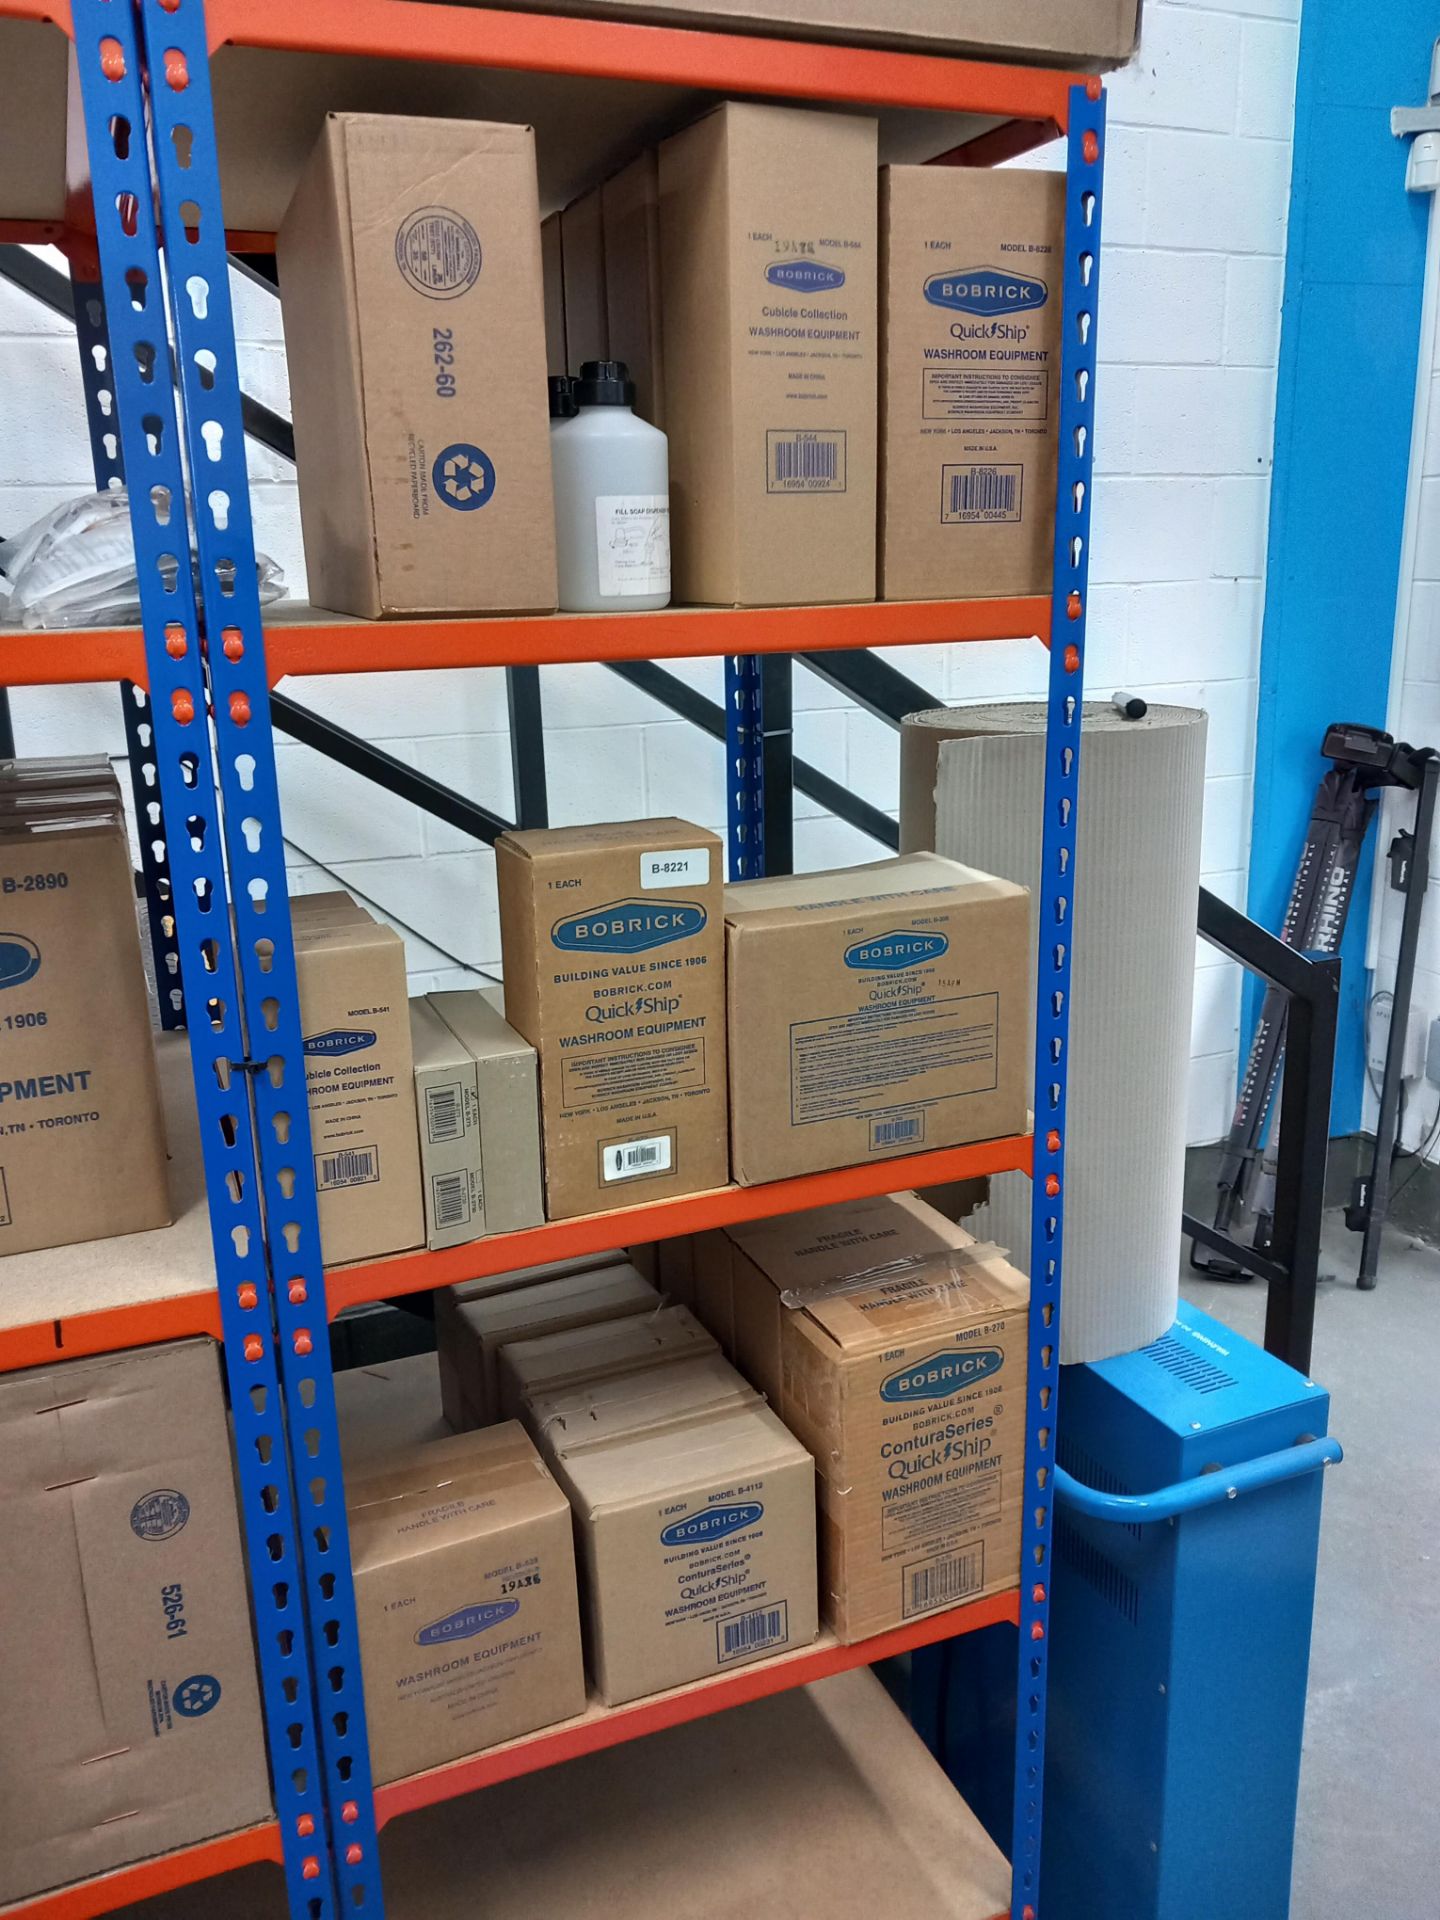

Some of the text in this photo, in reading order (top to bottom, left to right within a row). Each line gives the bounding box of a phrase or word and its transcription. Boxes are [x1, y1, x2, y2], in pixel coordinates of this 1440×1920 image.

[753, 232, 772, 241] EACH
[819, 239, 841, 248] MODEL
[930, 241, 951, 250] EACH
[1000, 244, 1027, 253] MODEL
[776, 269, 835, 282] BOBRICK
[942, 283, 1031, 299] BOBRICK
[762, 306, 848, 320] Cubicle Collection
[749, 327, 860, 340] WASHROOM EQUIPMENT
[433, 328, 456, 398] 262-60
[924, 348, 1048, 362] WASHROOM EQUIPMENT
[407, 433, 420, 519] RECYCLED PAPERBOARD
[417, 439, 429, 515] CARTON MADE FROM
[970, 467, 997, 476] B-8226
[783, 479, 805, 488] 16954
[958, 511, 980, 519] 16954
[984, 511, 1007, 519] 00445
[651, 861, 689, 874] B-8221
[2, 872, 69, 894] B-2890
[556, 879, 582, 889] EACH
[794, 897, 865, 912] HANDLE
[869, 892, 908, 902] WITH
[1311, 866, 1345, 952] RHINO
[575, 913, 686, 939] BOBRICK
[847, 928, 864, 936] EACH
[859, 941, 934, 960] BOBRICK
[554, 956, 707, 983] BUILDING VALUE SINCE 1906
[858, 975, 886, 984] BUILDING
[593, 980, 672, 999] BOBRICK.COM
[347, 1006, 390, 1017] MODEL B-541
[858, 995, 935, 1013] WASHROOM EQUIPMENT
[4, 1012, 48, 1030] 1906
[559, 1017, 706, 1048] WASHROOM EQUIPMENT
[308, 1035, 366, 1050] BOBRICK
[571, 1057, 606, 1067] IMPORTANT
[608, 1051, 651, 1062] INSTRUCTIONS
[661, 1044, 696, 1054] CONSIGNEE
[333, 1063, 381, 1077] Collection
[1239, 1022, 1271, 1126] INTERNATIONAL
[342, 1077, 395, 1091] EQUIPMENT
[610, 1100, 637, 1111] ANGELES
[684, 1087, 711, 1097] TORONTO
[36, 1111, 99, 1129] TORONTO
[794, 1229, 899, 1257] HANDLE WITH CARE
[816, 1228, 863, 1244] FRAGILE
[879, 1277, 929, 1295] FRAGILE
[859, 1295, 906, 1312] HANDLE
[908, 1287, 937, 1300] WITH
[956, 1322, 1005, 1342] MODEL B-270
[878, 1349, 905, 1363] 1 EACH
[899, 1356, 988, 1392] BOBRICK
[882, 1408, 925, 1426] BUILDING
[927, 1399, 956, 1413] VALUE
[958, 1391, 983, 1405] SINCE
[912, 1406, 975, 1431] BOBRICK.COM
[882, 1455, 1003, 1501] WASHROOM EQUIPMENT
[708, 1482, 763, 1503] MODEL B-4112
[397, 1499, 497, 1534] HANDLE WITH CARE
[420, 1500, 465, 1518] FRAGILE
[664, 1503, 687, 1515] EACH
[676, 1510, 749, 1538] BOBRICK
[663, 1549, 699, 1565] BUILDING
[701, 1543, 723, 1554] VALUE
[725, 1535, 747, 1546] SINCE
[689, 1549, 740, 1569] BOBRICK.COM
[484, 1565, 513, 1580] MODEL
[390, 1597, 416, 1611] EACH
[665, 1596, 717, 1617] WASHROOM
[718, 1581, 766, 1602] EQUIPMENT
[160, 1583, 188, 1640] 526-61
[430, 1605, 506, 1638] BOBRICK
[396, 1656, 470, 1688] WASHROOM
[474, 1632, 542, 1662] EQUIPMENT
